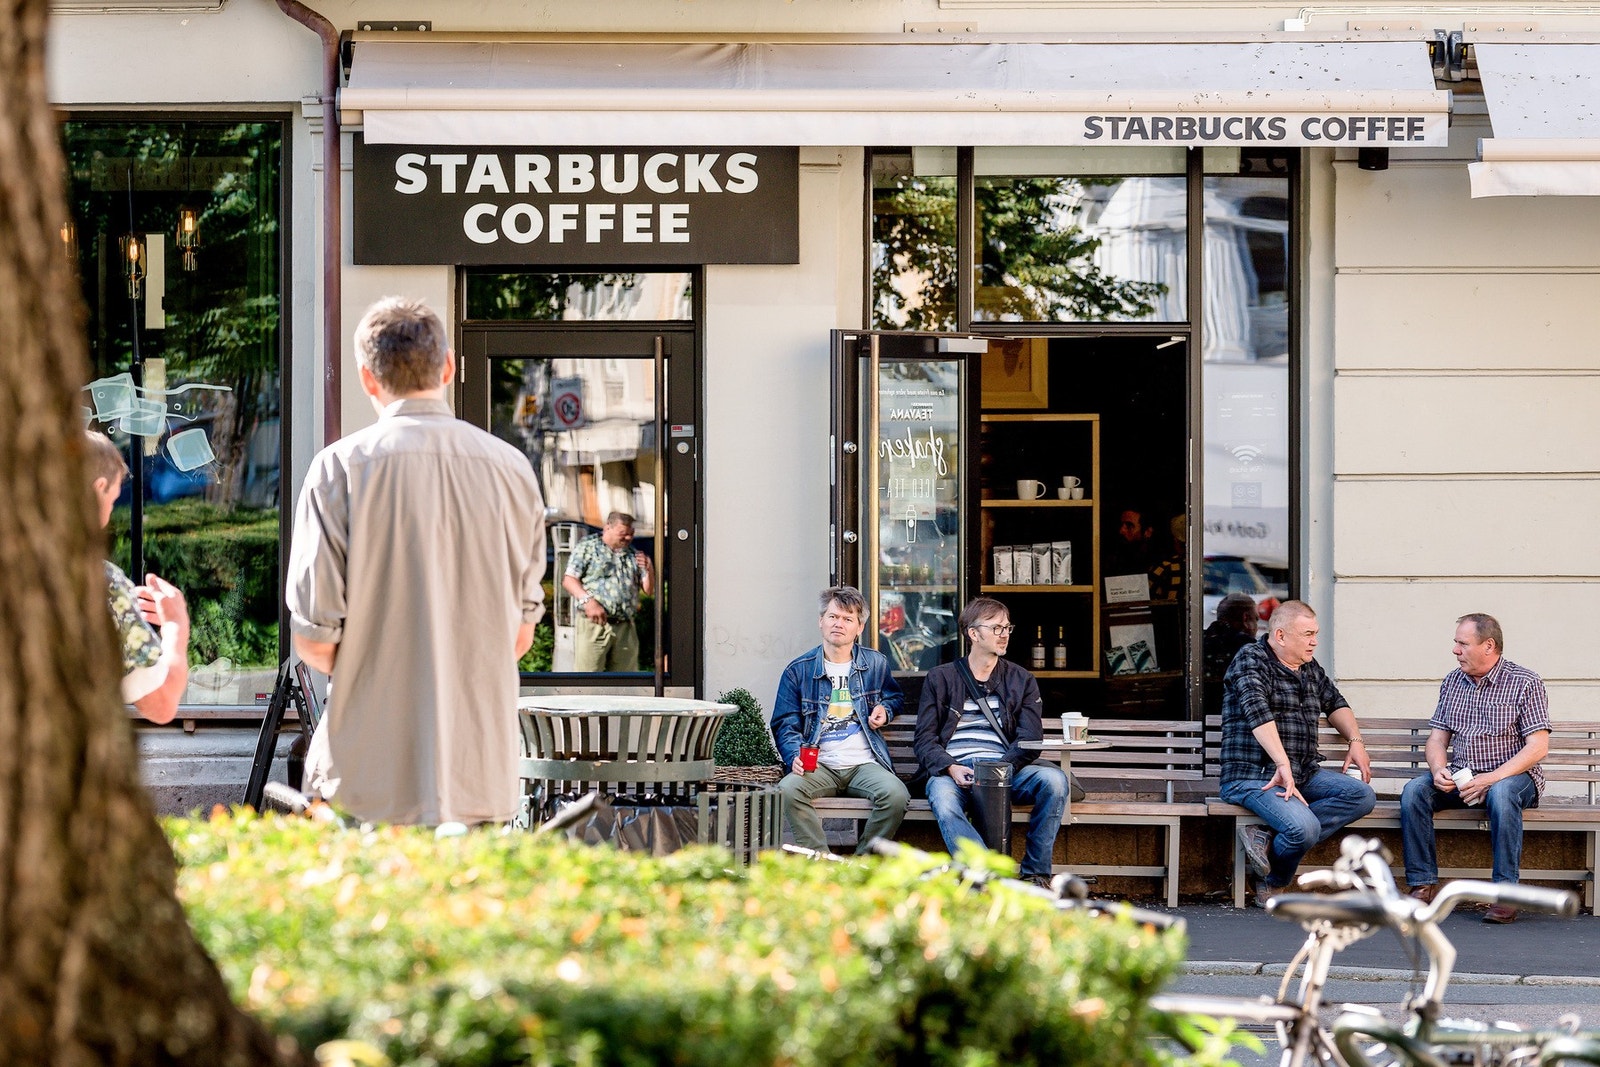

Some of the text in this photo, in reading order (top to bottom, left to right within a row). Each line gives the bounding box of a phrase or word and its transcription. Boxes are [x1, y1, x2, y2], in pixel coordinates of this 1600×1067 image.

[1083, 115, 1425, 141] STARBUCKS COFFEE
[394, 152, 759, 194] STARBUCKS
[463, 203, 690, 244] COFFEE
